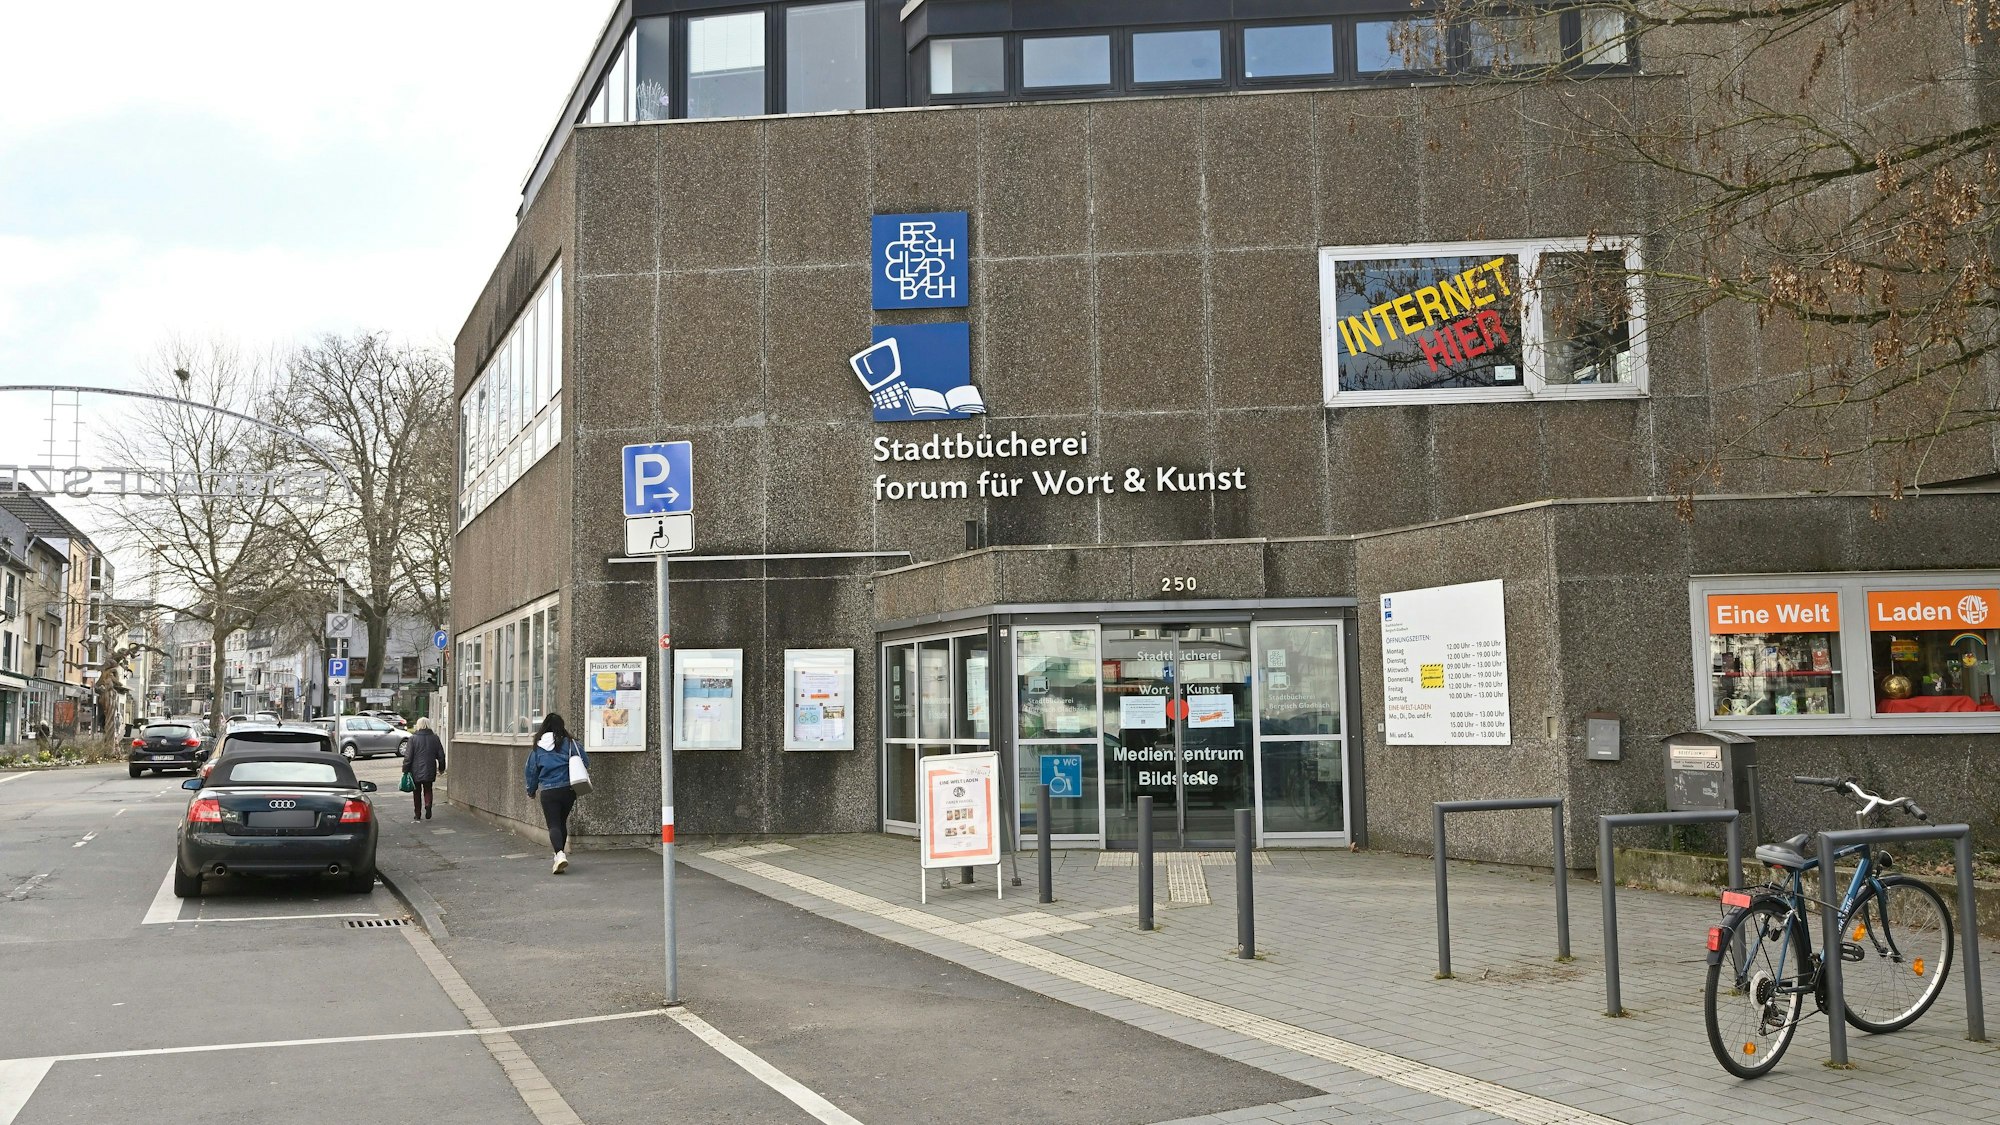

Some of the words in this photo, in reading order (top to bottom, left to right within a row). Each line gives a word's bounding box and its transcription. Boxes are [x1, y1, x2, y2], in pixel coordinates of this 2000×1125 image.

[1338, 257, 1511, 357] INTERNET
[1418, 309, 1509, 373] HIER
[873, 431, 1088, 462] Stadtbücherei
[635, 453, 670, 506] P
[874, 474, 968, 500] forum
[977, 471, 1023, 497] für
[1032, 469, 1114, 495] Wort
[1123, 467, 1146, 493] &
[1156, 466, 1247, 492] Kunst
[1161, 576, 1197, 592] 250
[1958, 594, 1987, 610] EINE
[1716, 605, 1769, 625] Eine
[1776, 603, 1830, 623] Welt
[1877, 602, 1952, 622] Laden
[1958, 608, 1988, 625] WELT
[1386, 648, 1404, 656] Montag
[1386, 657, 1407, 665] Dienstag
[1139, 684, 1170, 695] Wort
[1186, 684, 1221, 695] Kunst
[1063, 758, 1078, 766] WC
[1706, 761, 1720, 769] 250
